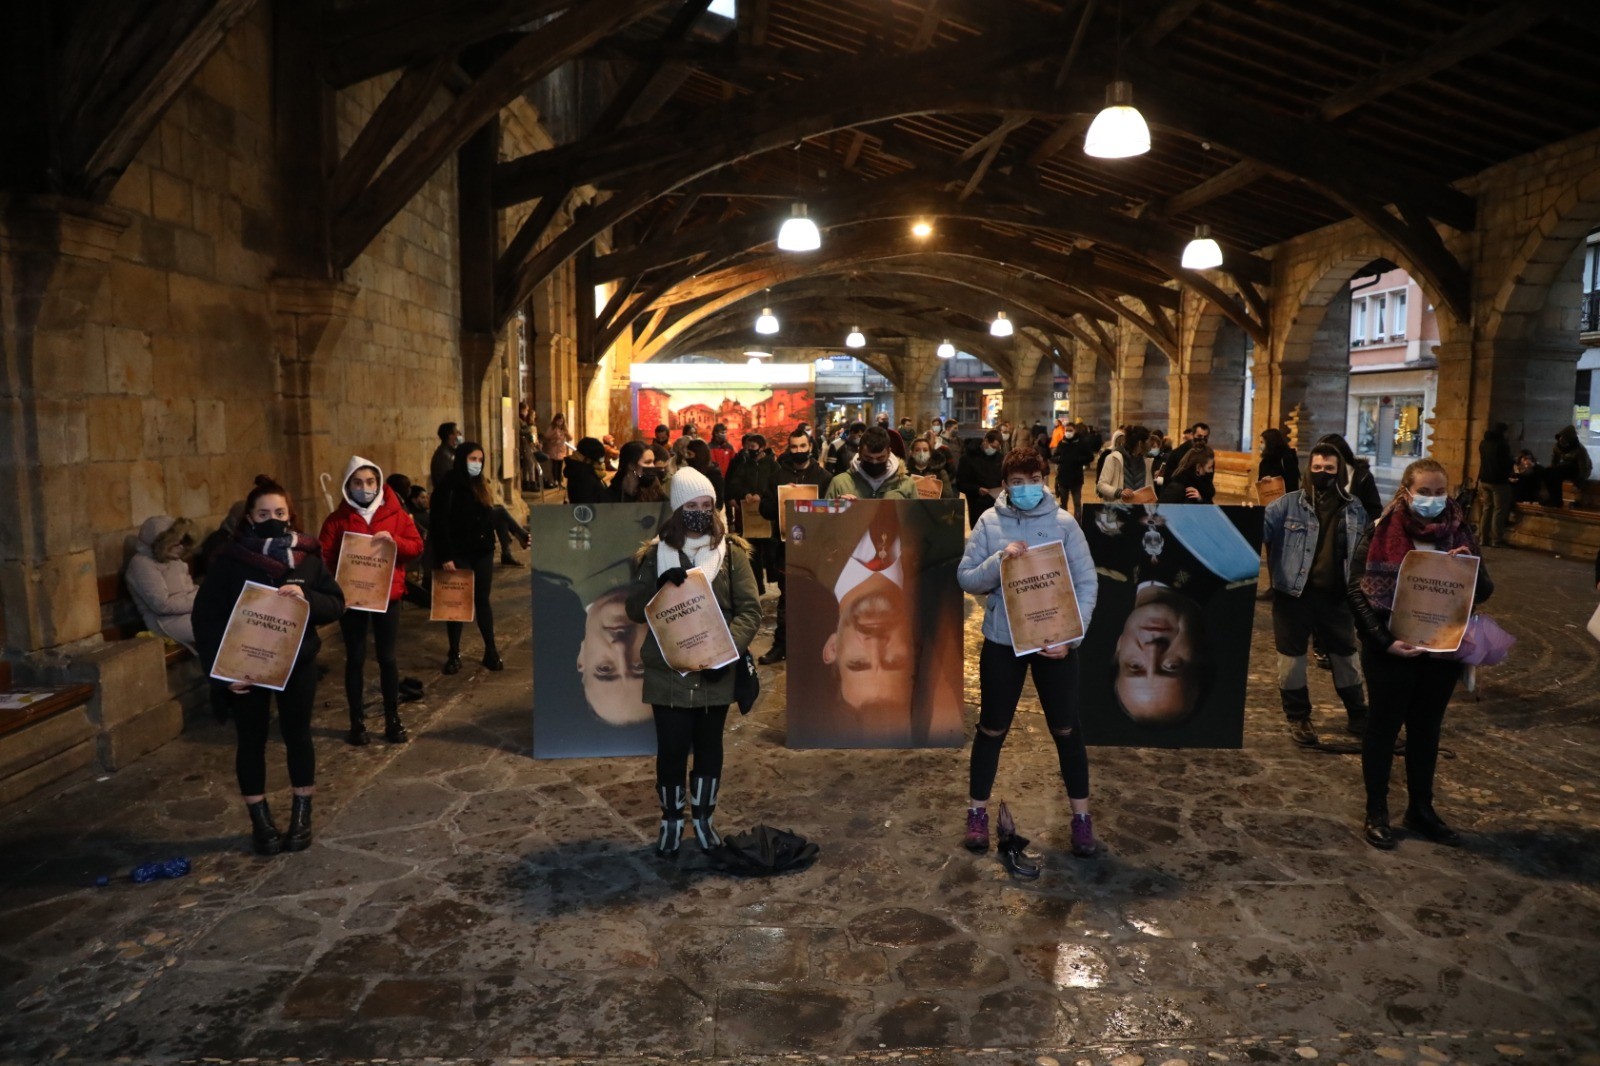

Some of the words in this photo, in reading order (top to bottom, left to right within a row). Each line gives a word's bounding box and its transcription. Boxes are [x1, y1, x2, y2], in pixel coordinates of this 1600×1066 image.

[1007, 569, 1062, 589] CONSTITUCION
[1015, 579, 1056, 595] ESPAÑOLA
[1406, 574, 1465, 590] CONSTITUCION
[1412, 583, 1456, 597] ESPAÑOLA
[655, 593, 706, 620] CONSTITUCION
[665, 603, 702, 625] ESPAÑOLA
[241, 608, 298, 629] CONSTITUCION
[246, 618, 288, 634] ESPAÑOLA
